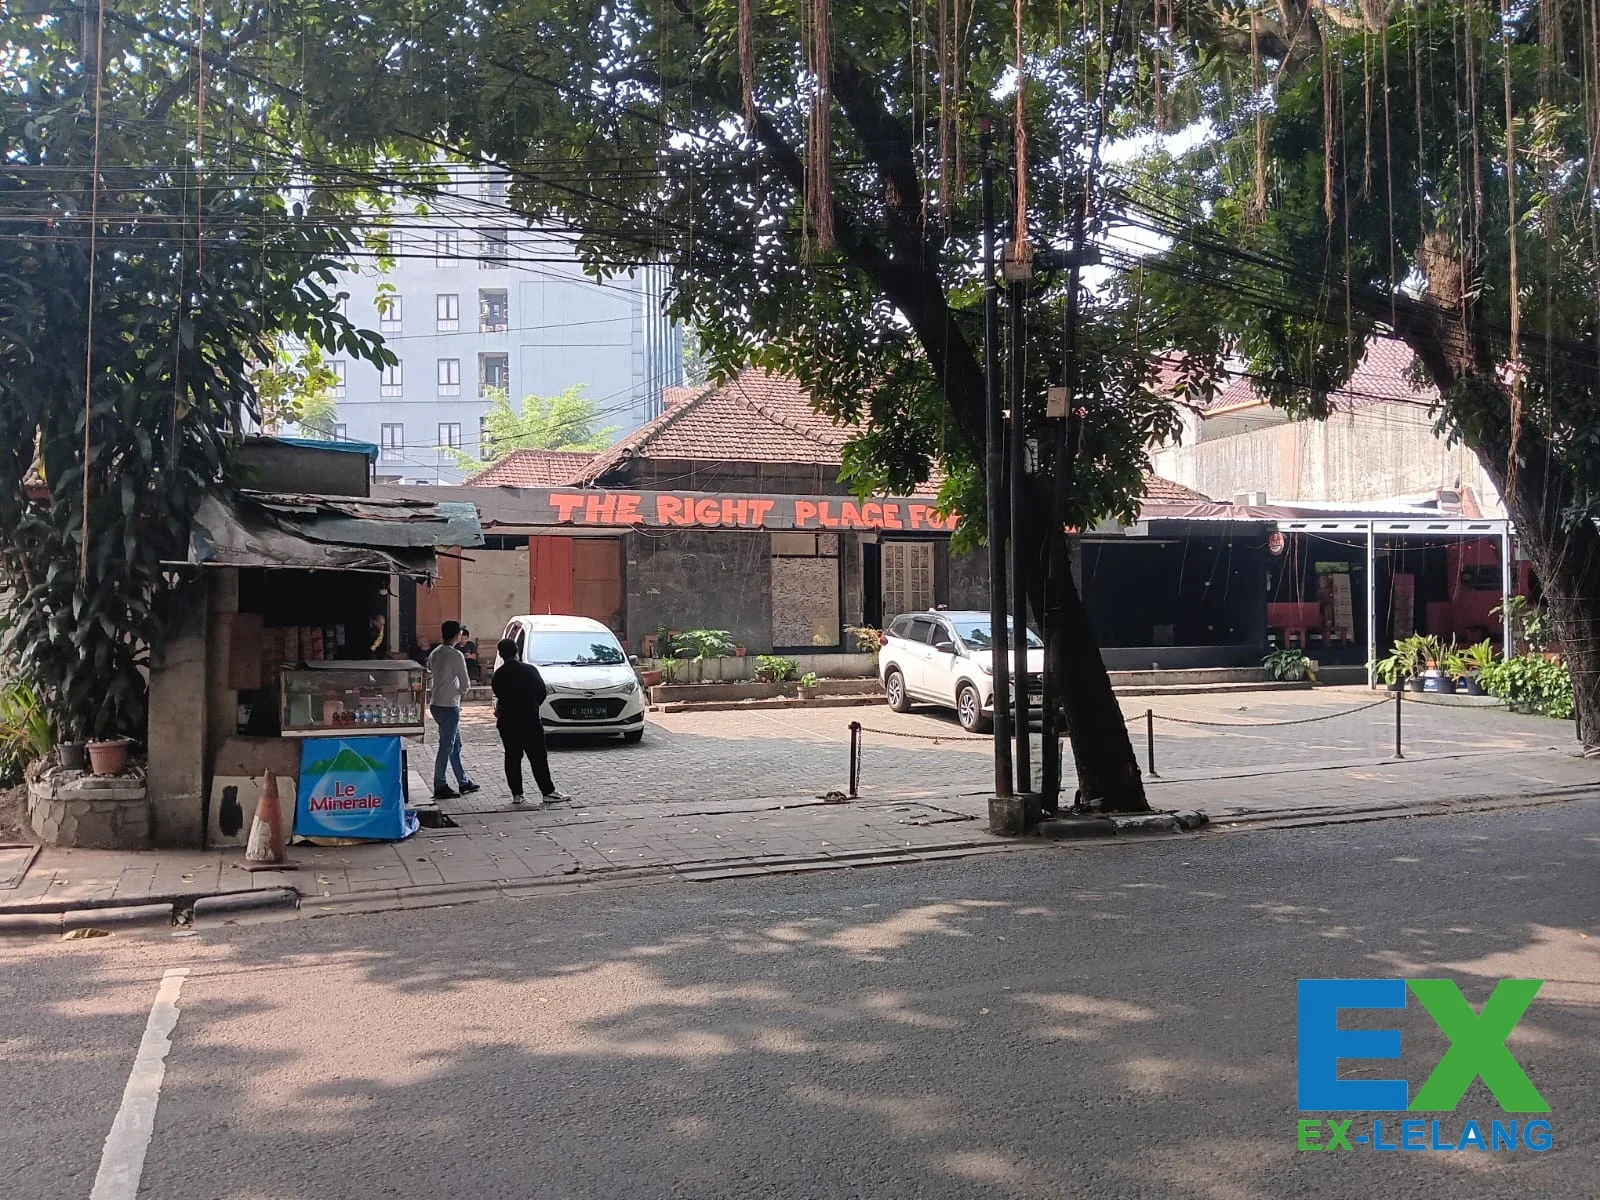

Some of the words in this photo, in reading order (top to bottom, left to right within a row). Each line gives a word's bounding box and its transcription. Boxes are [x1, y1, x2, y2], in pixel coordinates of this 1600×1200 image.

[549, 493, 644, 525] THE
[656, 494, 775, 526] RIGHT
[794, 500, 903, 529] PLACE
[335, 780, 356, 797] Le
[309, 793, 382, 813] Minerale
